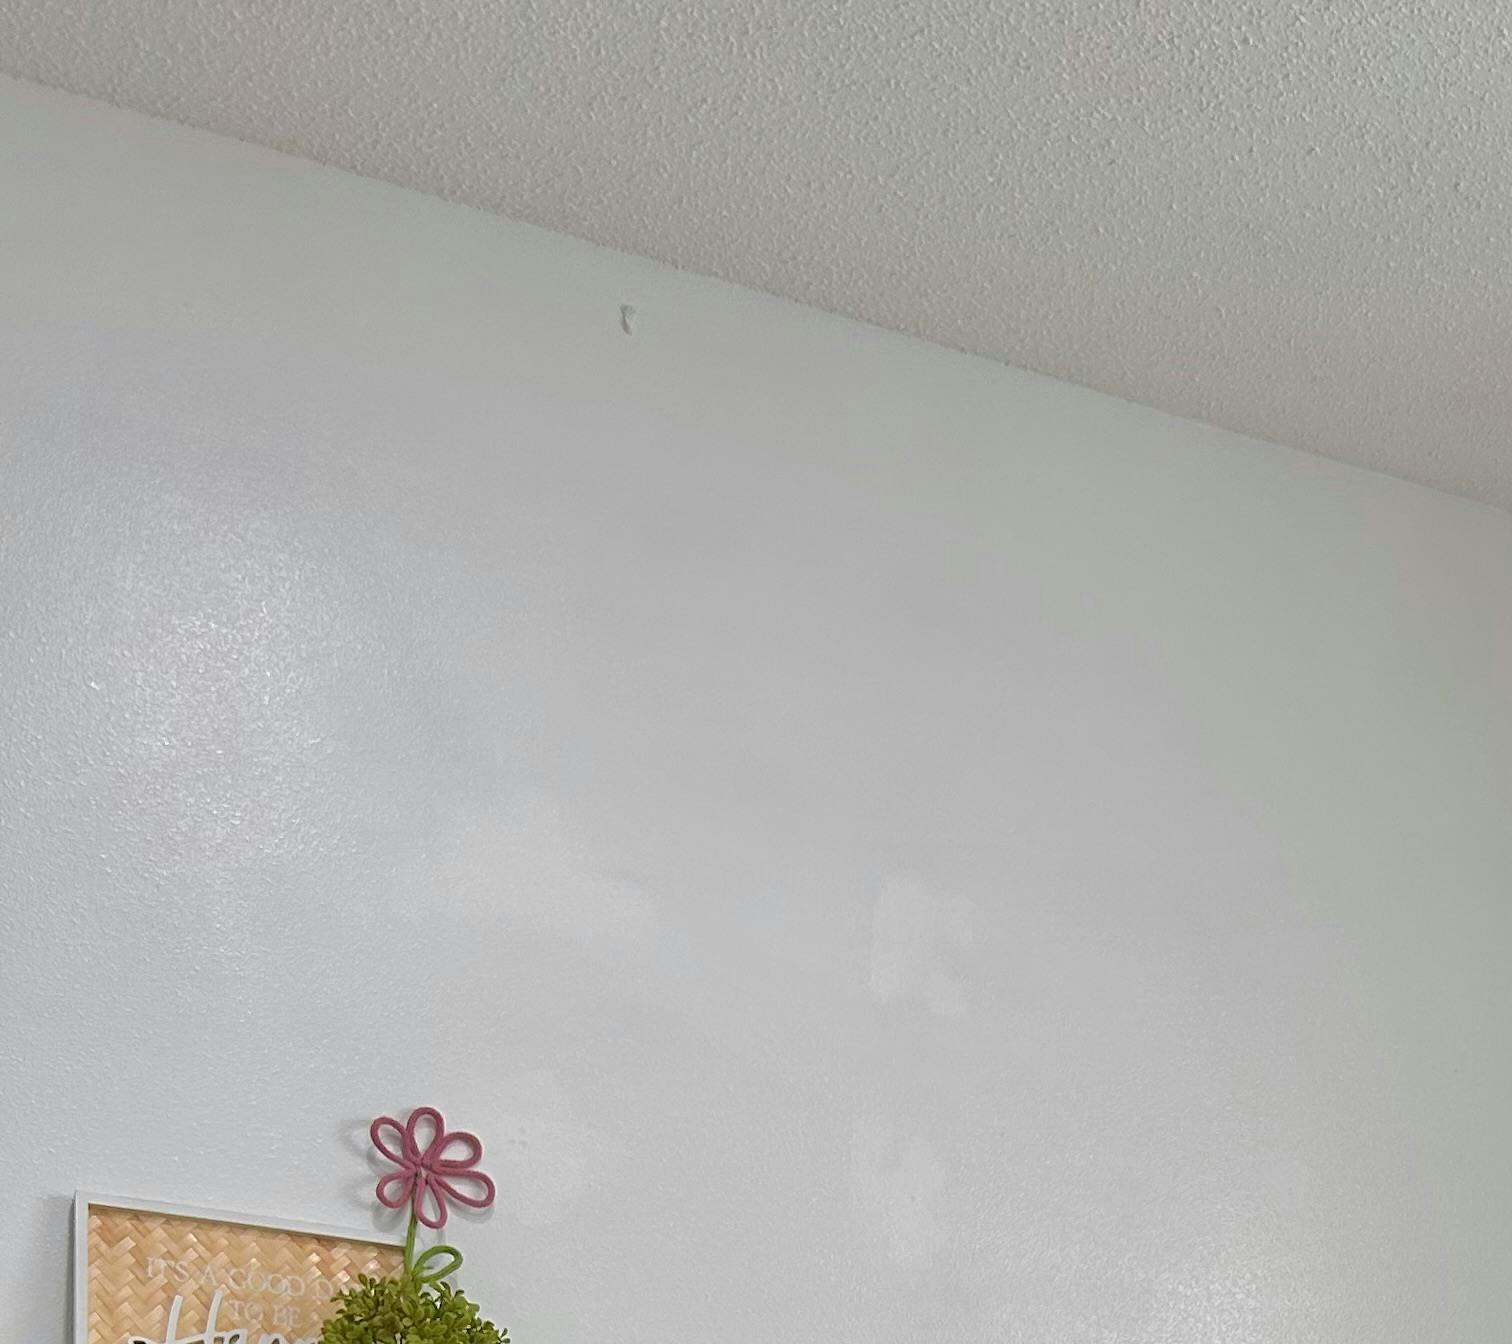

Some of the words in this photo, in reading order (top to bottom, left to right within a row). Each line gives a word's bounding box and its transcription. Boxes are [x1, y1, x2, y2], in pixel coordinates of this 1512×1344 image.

[146, 1256, 190, 1282] IT'S
[199, 1264, 218, 1286] A
[227, 1268, 304, 1297] GOOD
[231, 1300, 264, 1323] TO
[273, 1305, 303, 1328] BE
